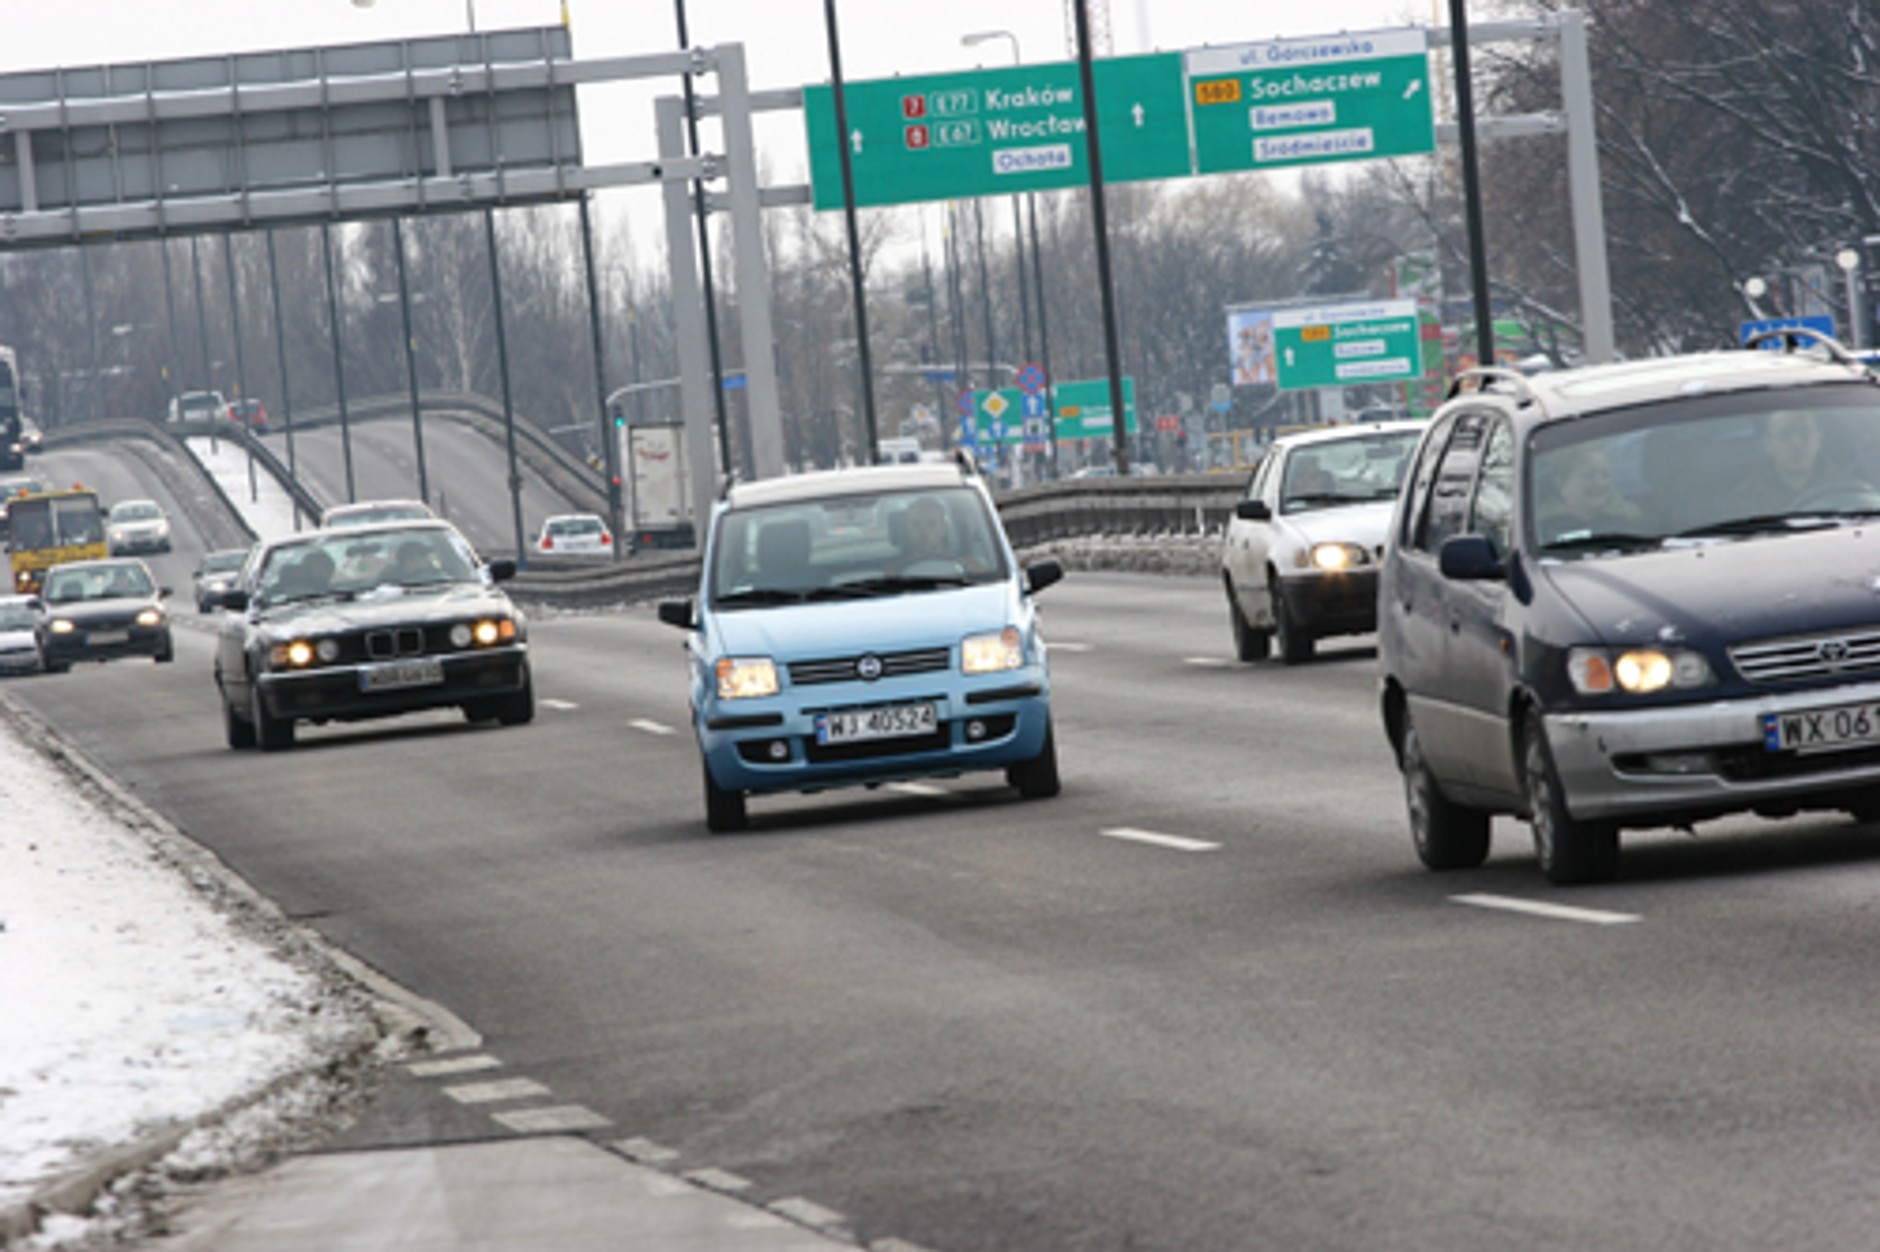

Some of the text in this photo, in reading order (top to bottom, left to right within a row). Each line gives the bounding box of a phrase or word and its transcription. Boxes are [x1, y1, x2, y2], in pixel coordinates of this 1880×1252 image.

[985, 83, 1073, 110] Kraków
[1251, 71, 1381, 99] Sochaczew
[1255, 108, 1330, 126] Bemowo
[998, 151, 1067, 171] Ochota
[830, 705, 932, 738] WJ 40524
[1782, 713, 1825, 746] WX
